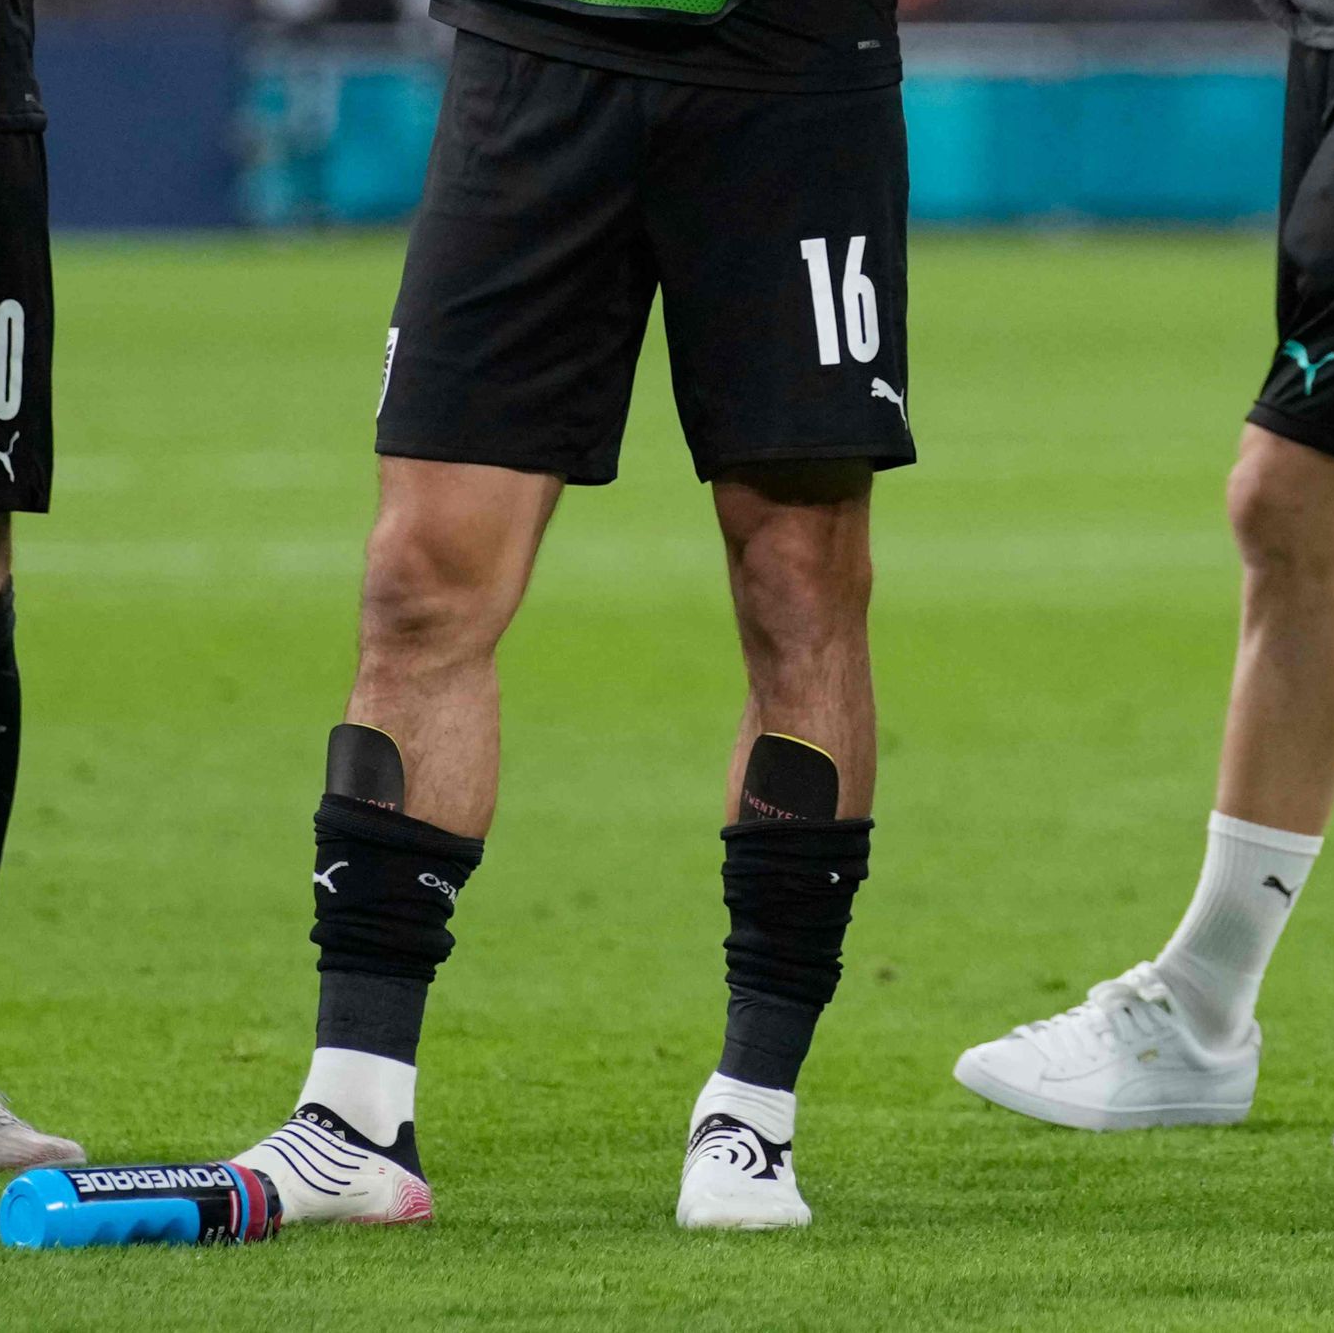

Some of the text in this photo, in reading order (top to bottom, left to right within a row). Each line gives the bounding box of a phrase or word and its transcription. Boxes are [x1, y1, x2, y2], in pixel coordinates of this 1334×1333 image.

[799, 235, 881, 366] 16
[295, 1110, 347, 1141] COPA
[67, 1167, 236, 1193] POWERADE
